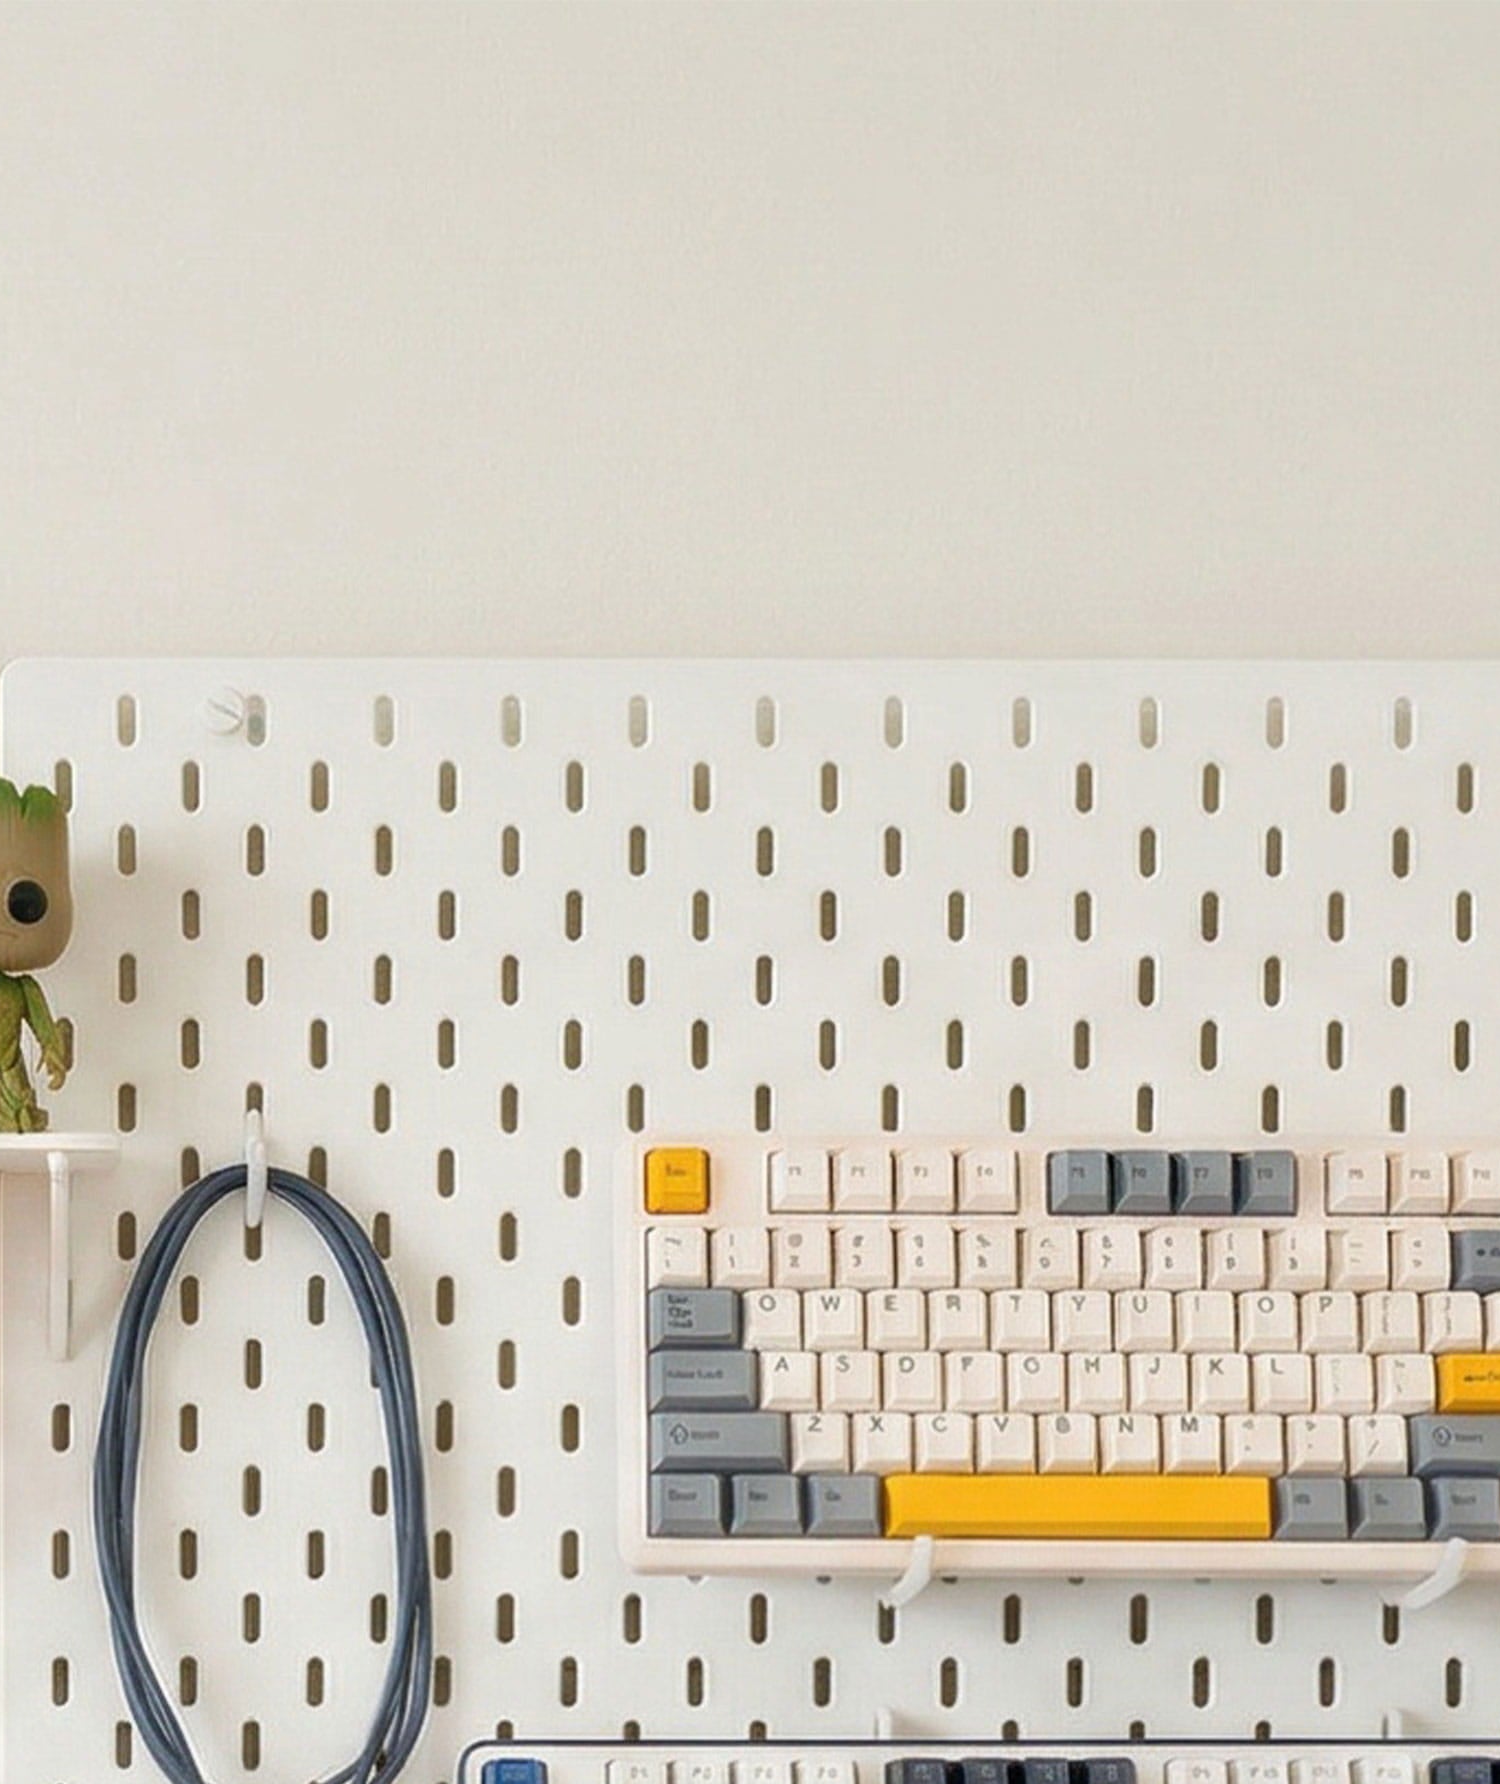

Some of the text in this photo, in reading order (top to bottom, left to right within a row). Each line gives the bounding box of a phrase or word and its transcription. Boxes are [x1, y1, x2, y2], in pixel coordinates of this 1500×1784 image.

[884, 1295, 899, 1312] E
[1257, 1295, 1275, 1312] O
[774, 1357, 789, 1373] A
